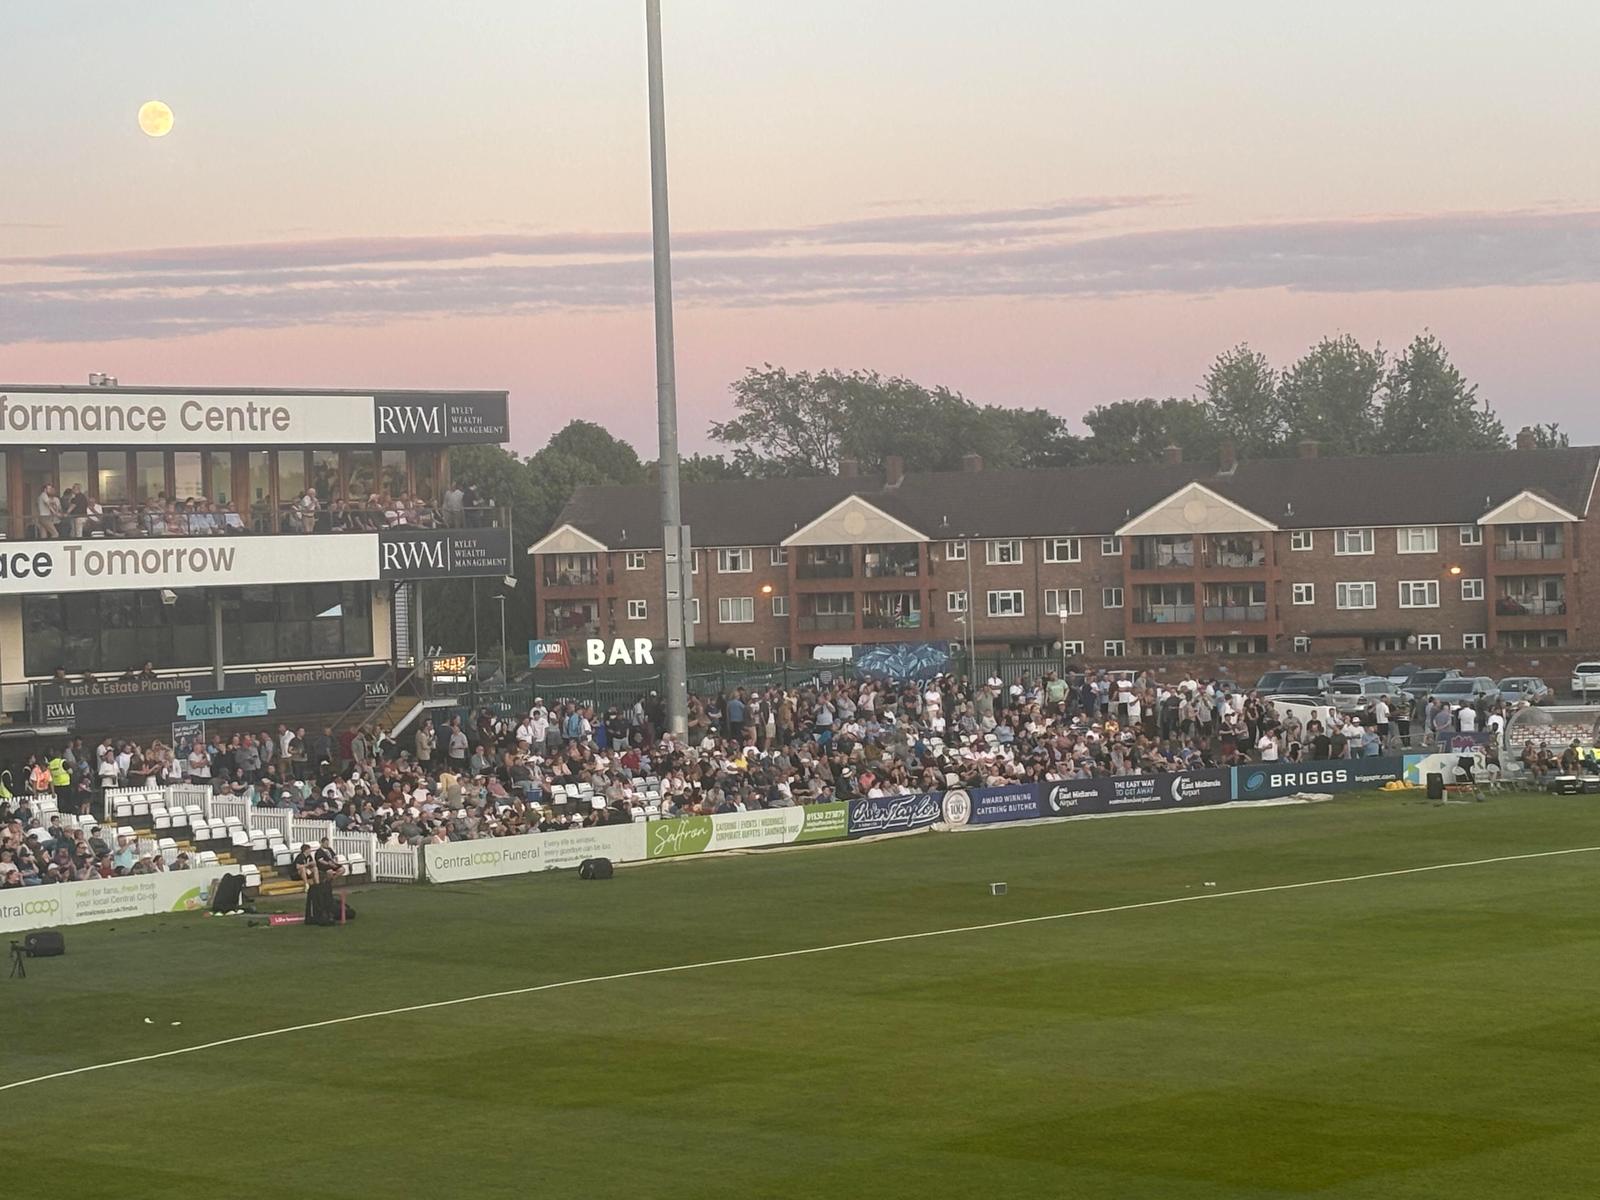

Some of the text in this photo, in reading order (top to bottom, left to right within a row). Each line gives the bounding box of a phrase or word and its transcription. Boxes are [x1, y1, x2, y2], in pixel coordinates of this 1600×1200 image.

[179, 400, 291, 432] Centre
[451, 406, 474, 415] RYLEY
[378, 406, 441, 434] RWM
[451, 416, 483, 424] WEALTH
[452, 425, 504, 434] MANAGEMENT
[454, 539, 478, 548] RYLEY
[382, 540, 445, 570] RWM
[454, 549, 486, 558] WEALTH
[63, 545, 236, 577] Tomorrow
[454, 558, 507, 568] MANAGEMENT
[586, 638, 655, 666] BAR
[255, 668, 362, 685] Retirement Planning
[60, 678, 192, 697] Trust & Estate Planning
[46, 702, 76, 717] RWM
[188, 703, 233, 717] Vouched
[1114, 781, 1125, 789] THE
[1140, 779, 1155, 787] WAY
[1181, 779, 1221, 790] East Midlands
[1270, 769, 1348, 788] BRIGGS
[1059, 789, 1098, 800] East Midlands
[1115, 787, 1154, 796] TO GET AWAY
[1181, 789, 1200, 797] Airport
[982, 793, 1032, 804] AWARD WINNING
[1059, 799, 1078, 807] Airport
[881, 795, 940, 829] Taylor
[950, 803, 964, 815] 100
[977, 802, 1037, 815] CATERING BUTCHER
[654, 818, 708, 855] Saffron
[434, 854, 474, 870] Central
[503, 847, 540, 862] Funeral
[110, 893, 136, 905] Central
